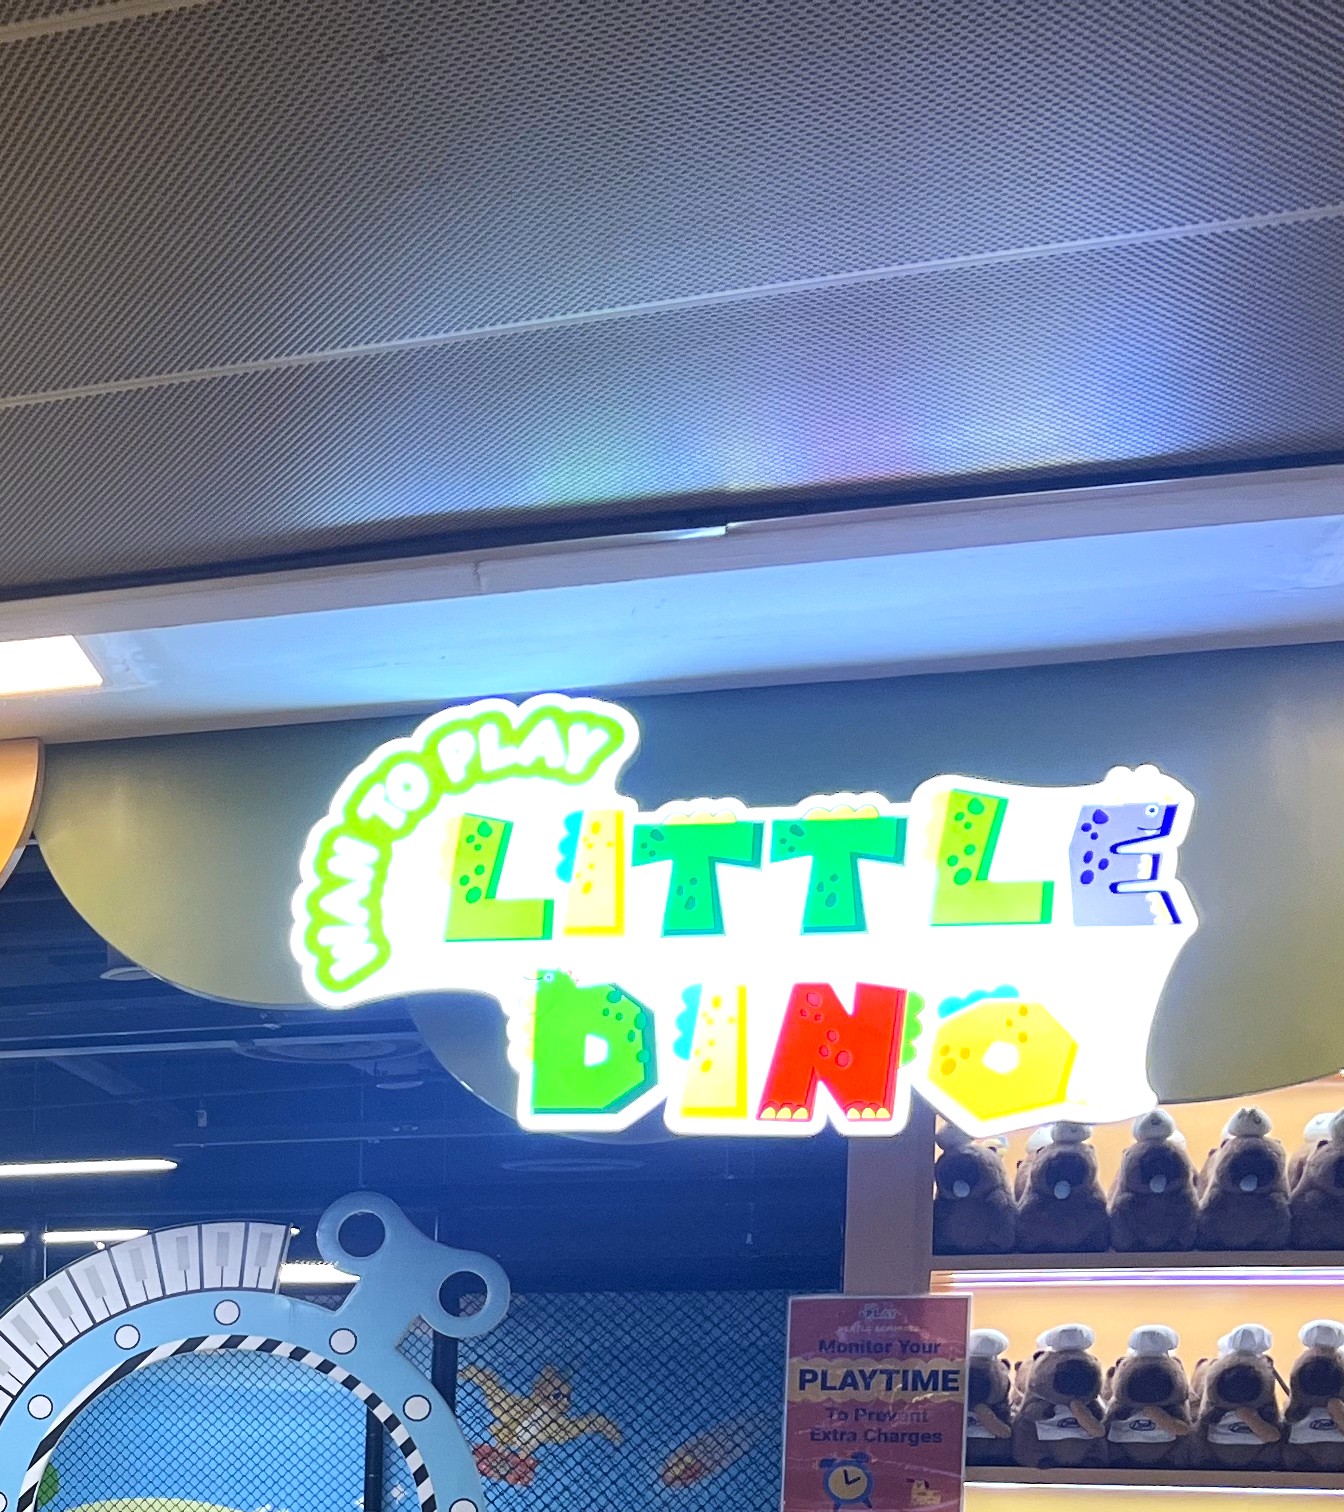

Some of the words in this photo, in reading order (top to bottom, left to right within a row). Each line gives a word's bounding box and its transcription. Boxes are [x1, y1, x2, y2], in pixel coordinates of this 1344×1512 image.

[316, 834, 380, 982] WAN
[356, 761, 430, 829] TO
[437, 717, 610, 783] PLAY
[443, 788, 1184, 942] LITTLE
[530, 969, 1080, 1121] DINO
[818, 1339, 893, 1354] Monitor
[899, 1339, 942, 1354] Your
[798, 1368, 960, 1392] PLAYTIME
[826, 1407, 848, 1421] To
[810, 1429, 857, 1442] Extra
[864, 1428, 943, 1446] Charges
